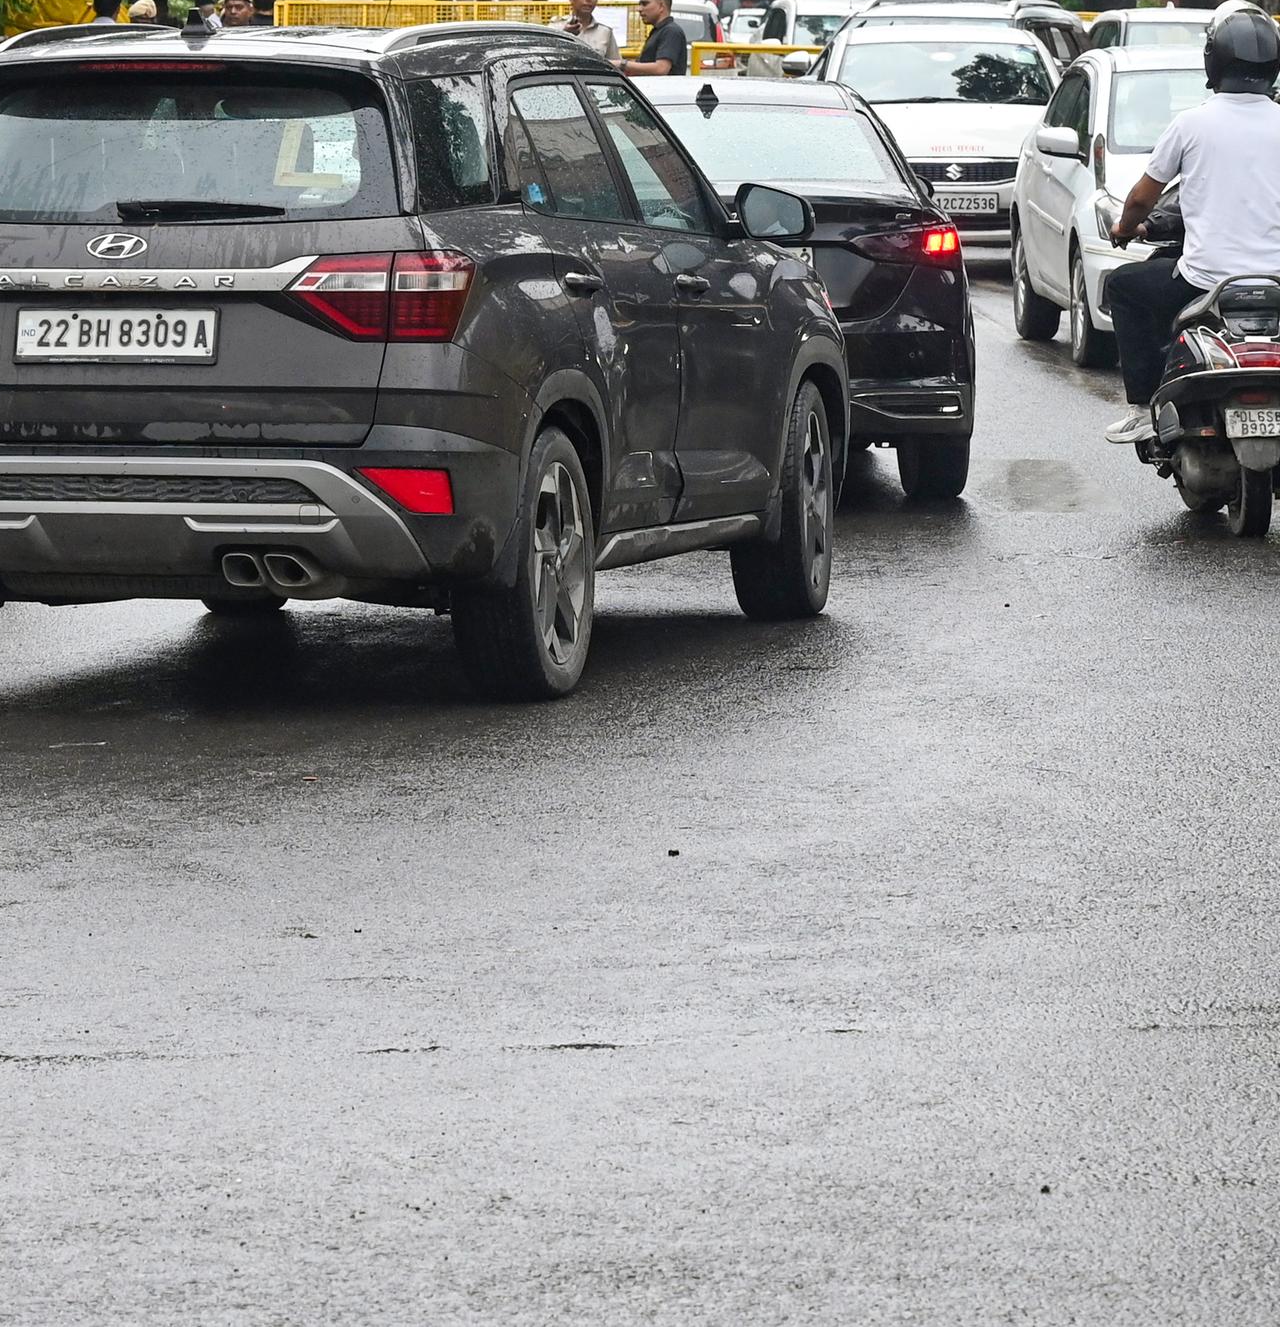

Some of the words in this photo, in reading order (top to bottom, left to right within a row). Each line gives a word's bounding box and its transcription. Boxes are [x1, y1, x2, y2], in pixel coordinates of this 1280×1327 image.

[20, 328, 36, 337] IND
[36, 319, 70, 348] 22
[77, 319, 111, 348] BH
[119, 319, 187, 348] 8309
[193, 319, 209, 349] A
